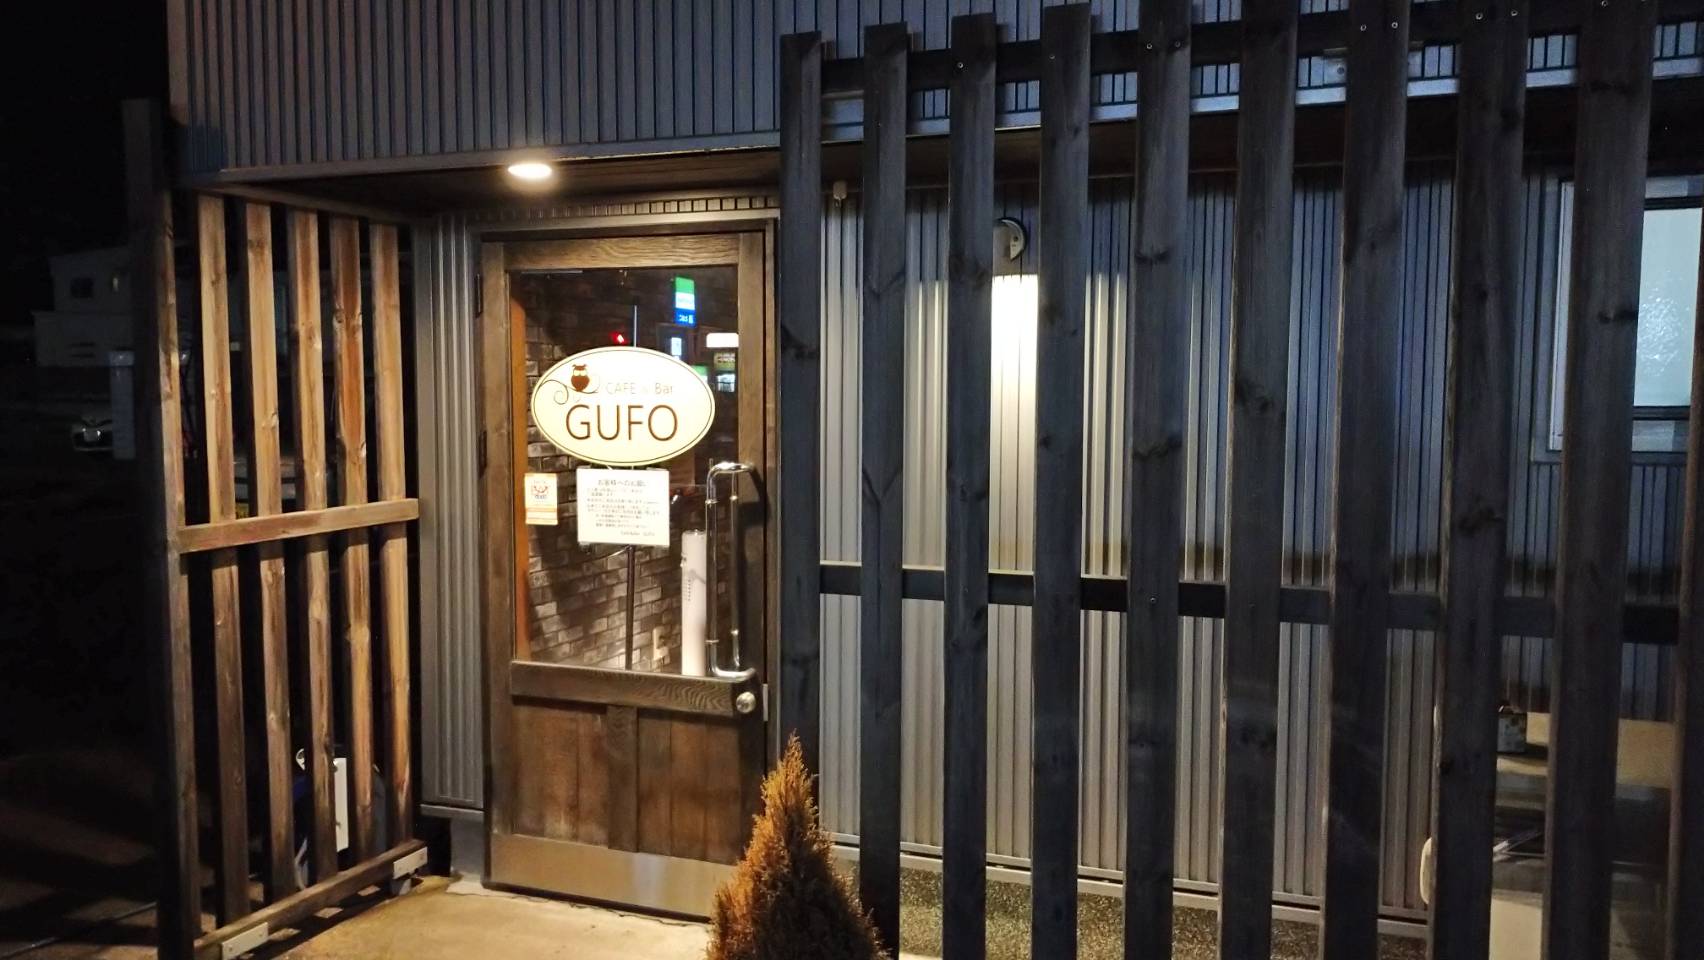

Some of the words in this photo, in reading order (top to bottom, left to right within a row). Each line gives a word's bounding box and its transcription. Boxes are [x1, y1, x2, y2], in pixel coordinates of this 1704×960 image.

[605, 382, 637, 395] CAFE
[654, 382, 673, 395] Bar
[566, 404, 678, 441] GUFO
